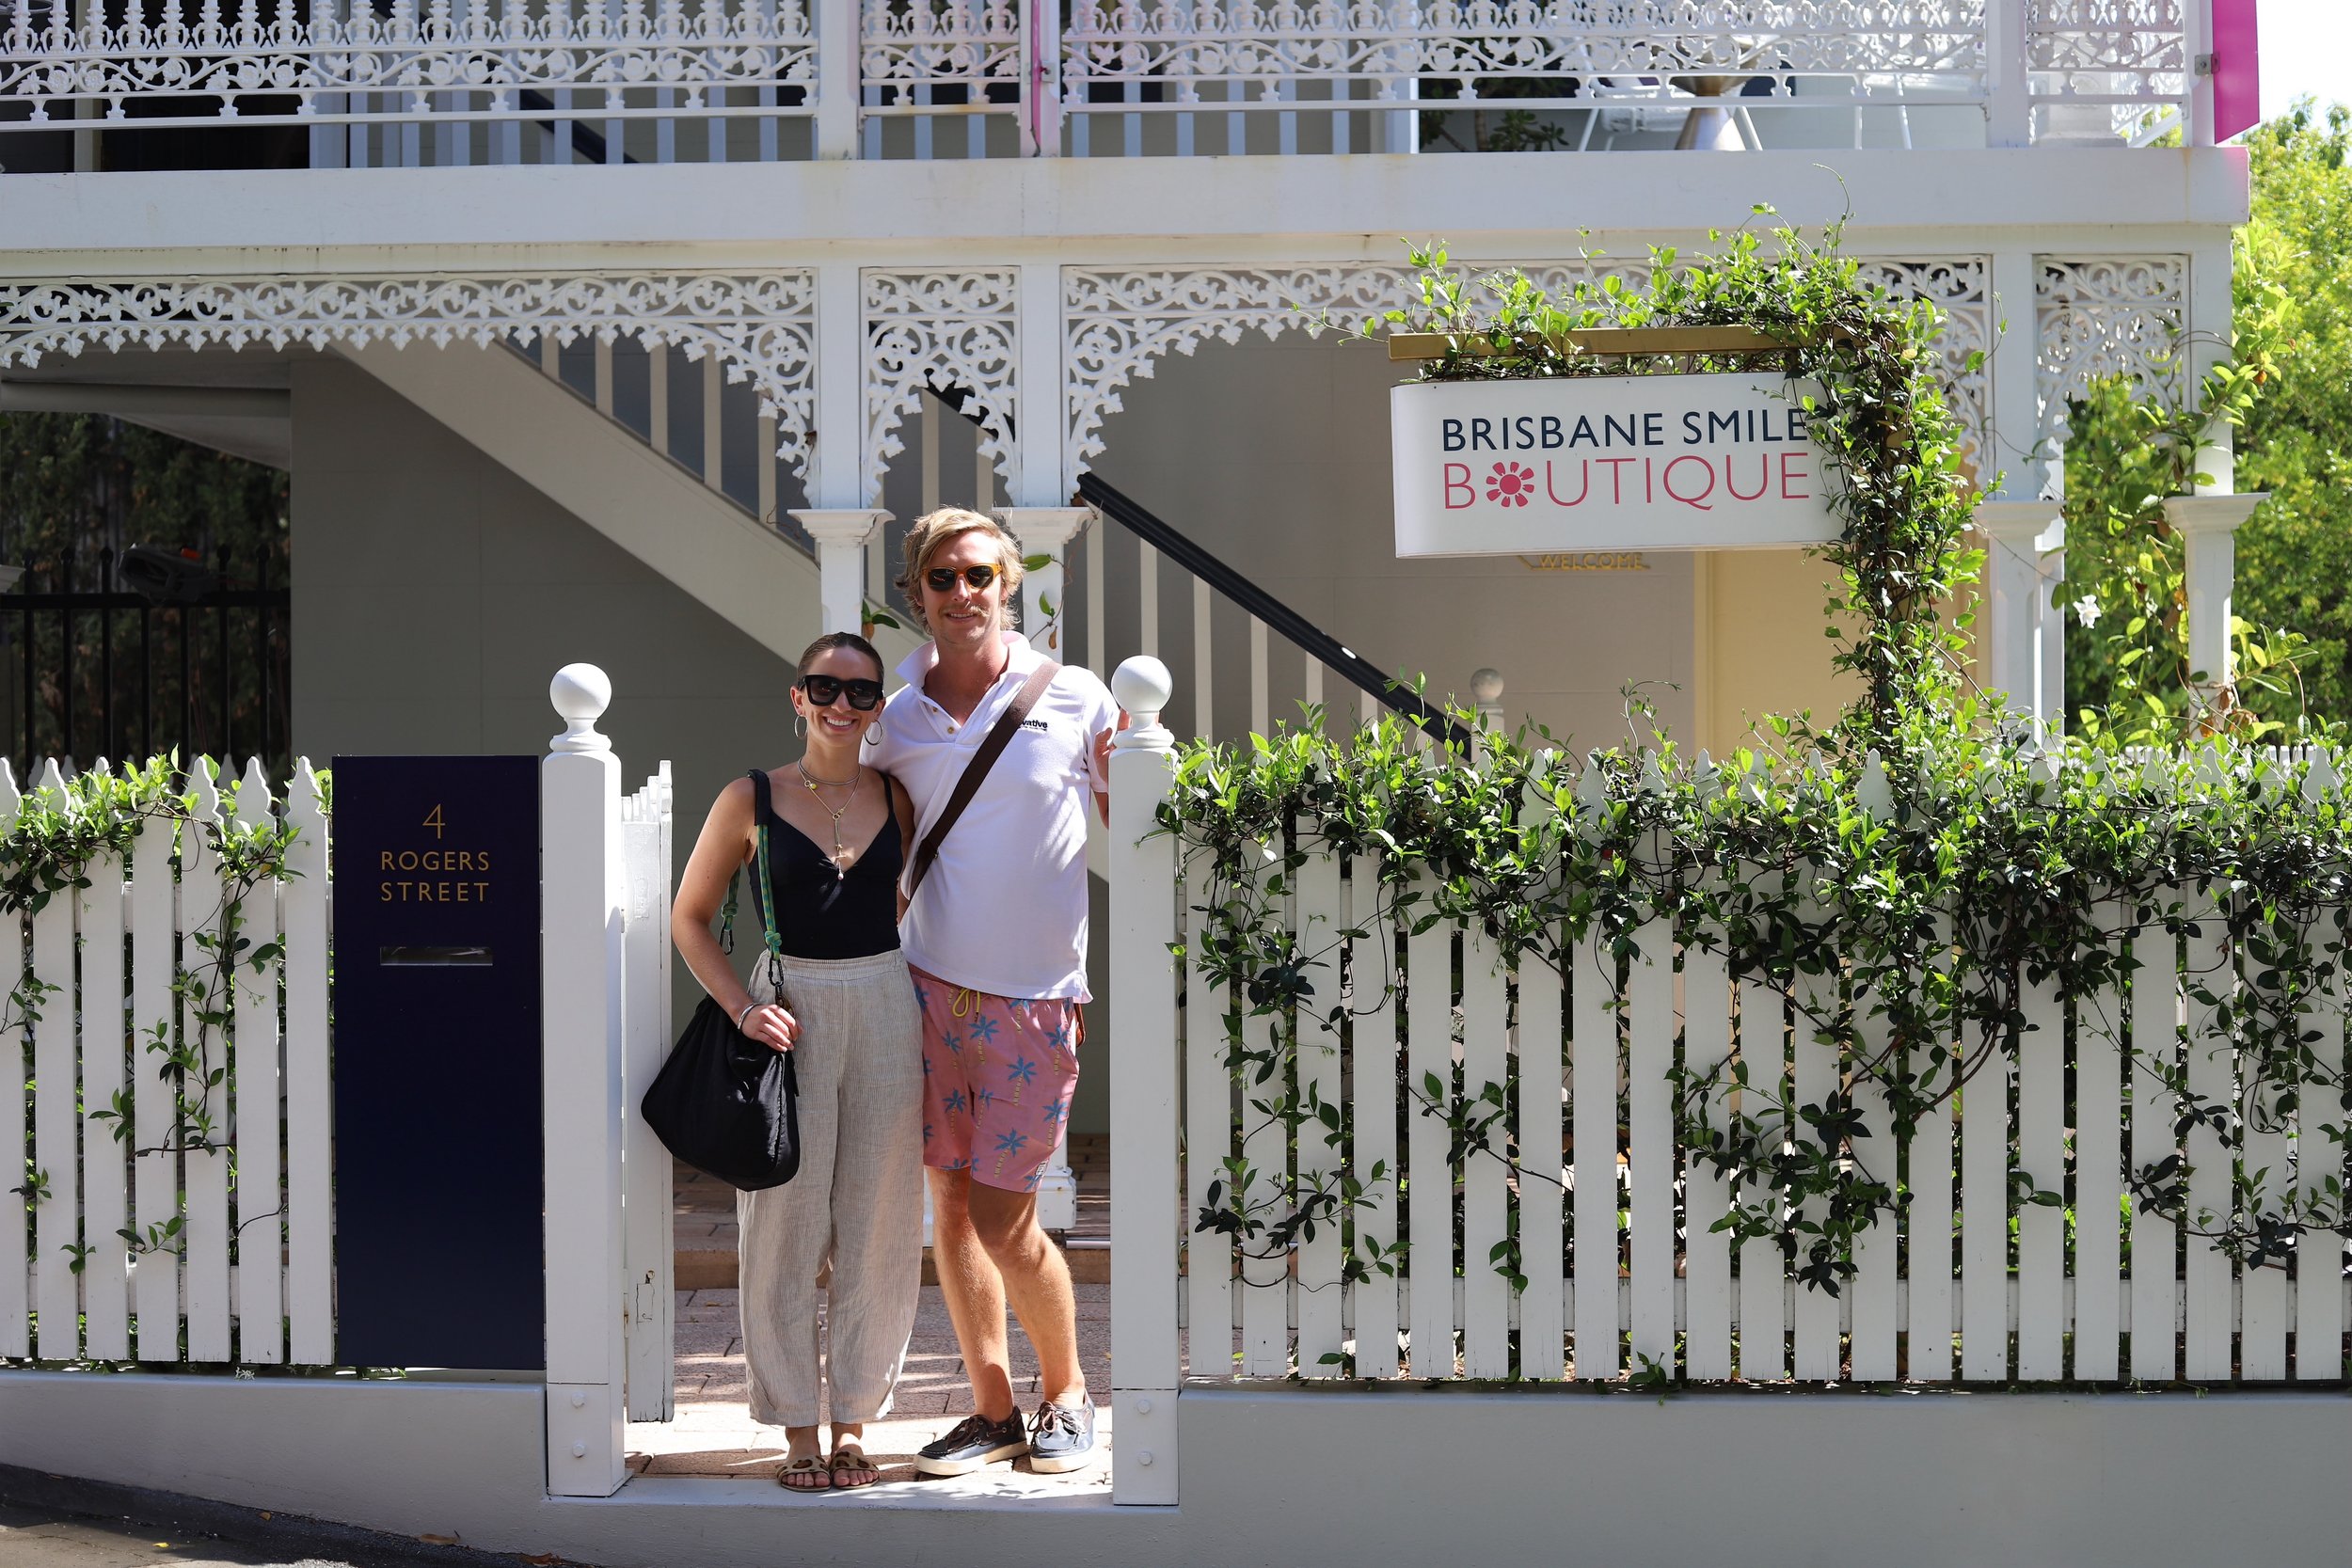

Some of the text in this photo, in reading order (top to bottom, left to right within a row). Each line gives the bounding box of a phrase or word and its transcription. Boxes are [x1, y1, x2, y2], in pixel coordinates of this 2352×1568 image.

[1442, 408, 1807, 451] BRISBANE SMILE
[1539, 552, 1644, 570] WELCOME
[422, 803, 446, 839] 4
[381, 850, 489, 871] ROGERS
[381, 881, 489, 902] STREET
